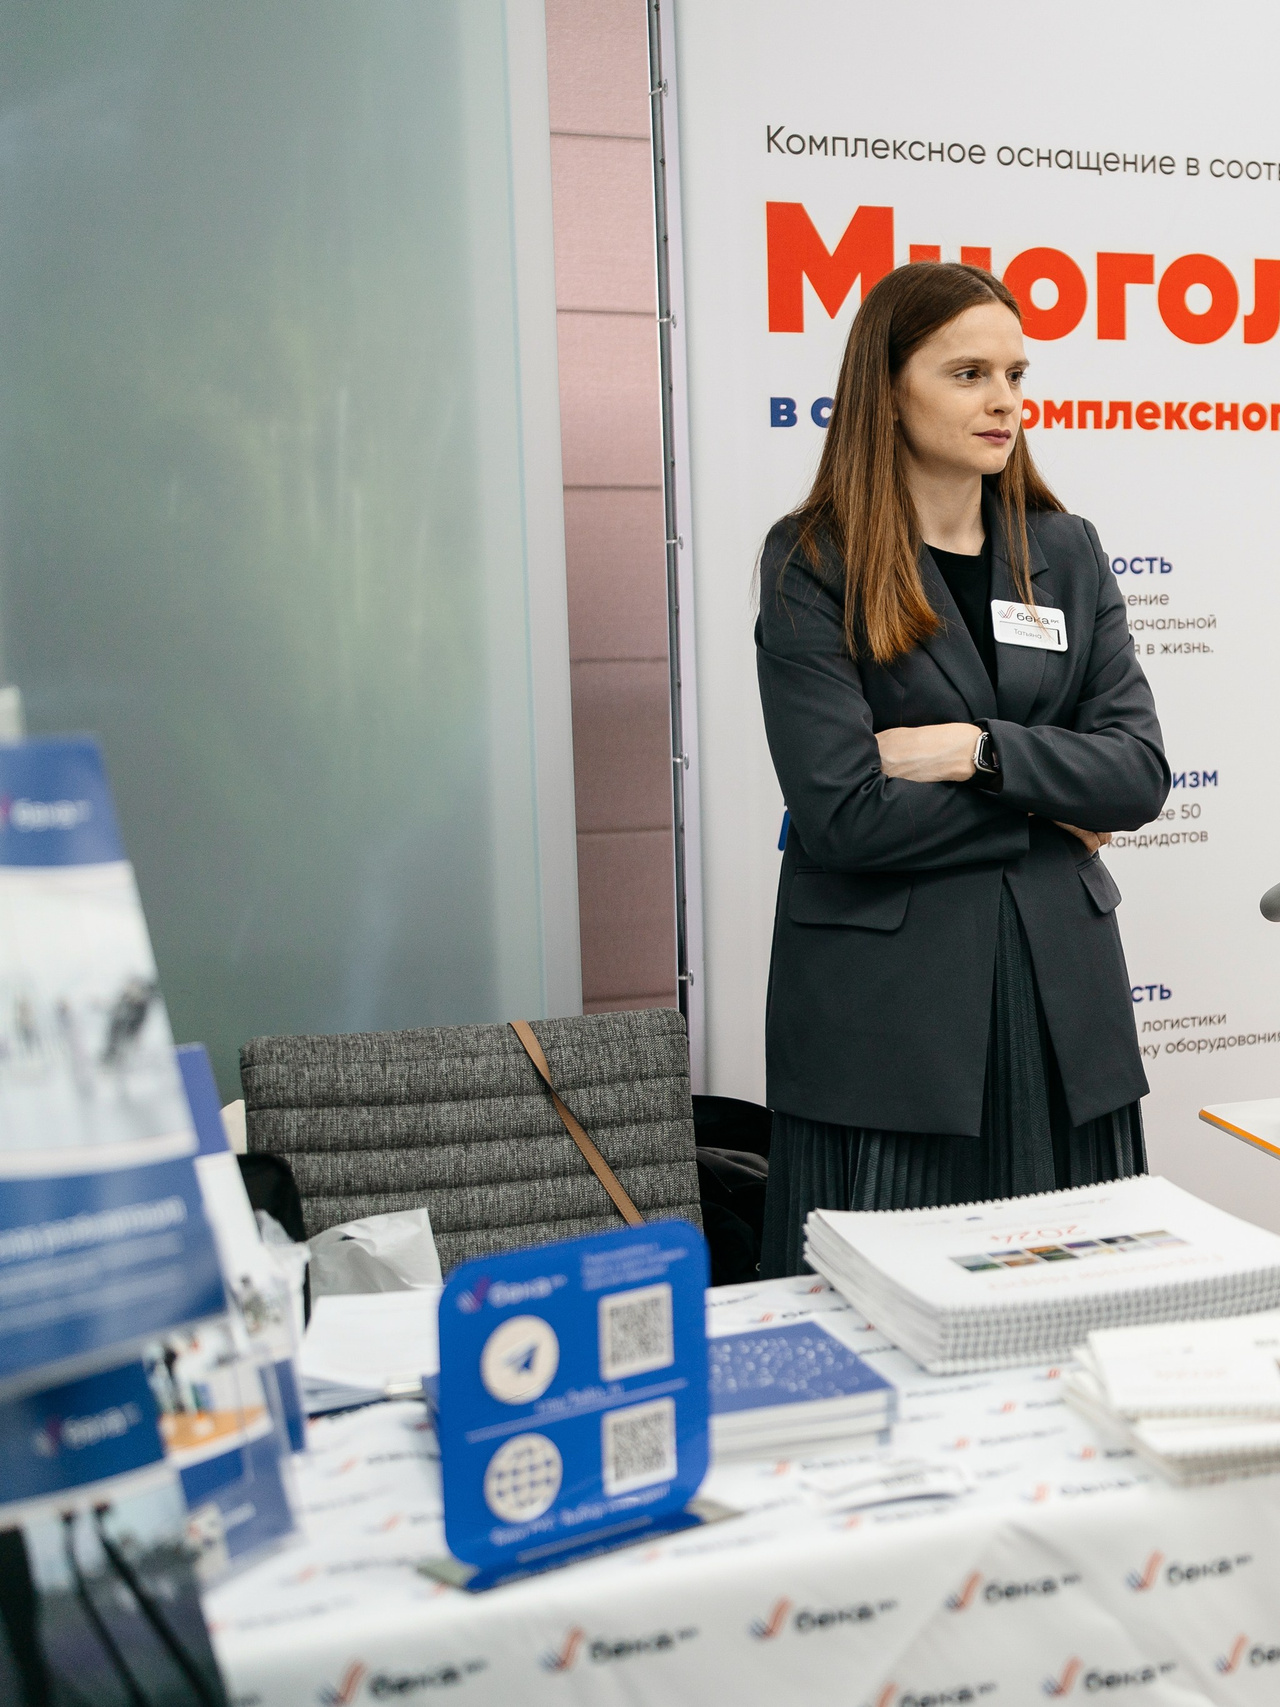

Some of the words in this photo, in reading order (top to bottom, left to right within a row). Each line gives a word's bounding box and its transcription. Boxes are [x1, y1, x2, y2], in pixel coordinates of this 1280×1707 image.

[766, 125, 987, 167] Комплексное
[997, 143, 1175, 178] оснащение
[1185, 158, 1199, 177] в
[770, 397, 798, 428] в
[1146, 643, 1155, 655] в
[1160, 641, 1214, 655] жизнь.
[1181, 803, 1202, 819] 50
[1108, 830, 1208, 849] кандидатов
[1142, 1013, 1227, 1033] логистики
